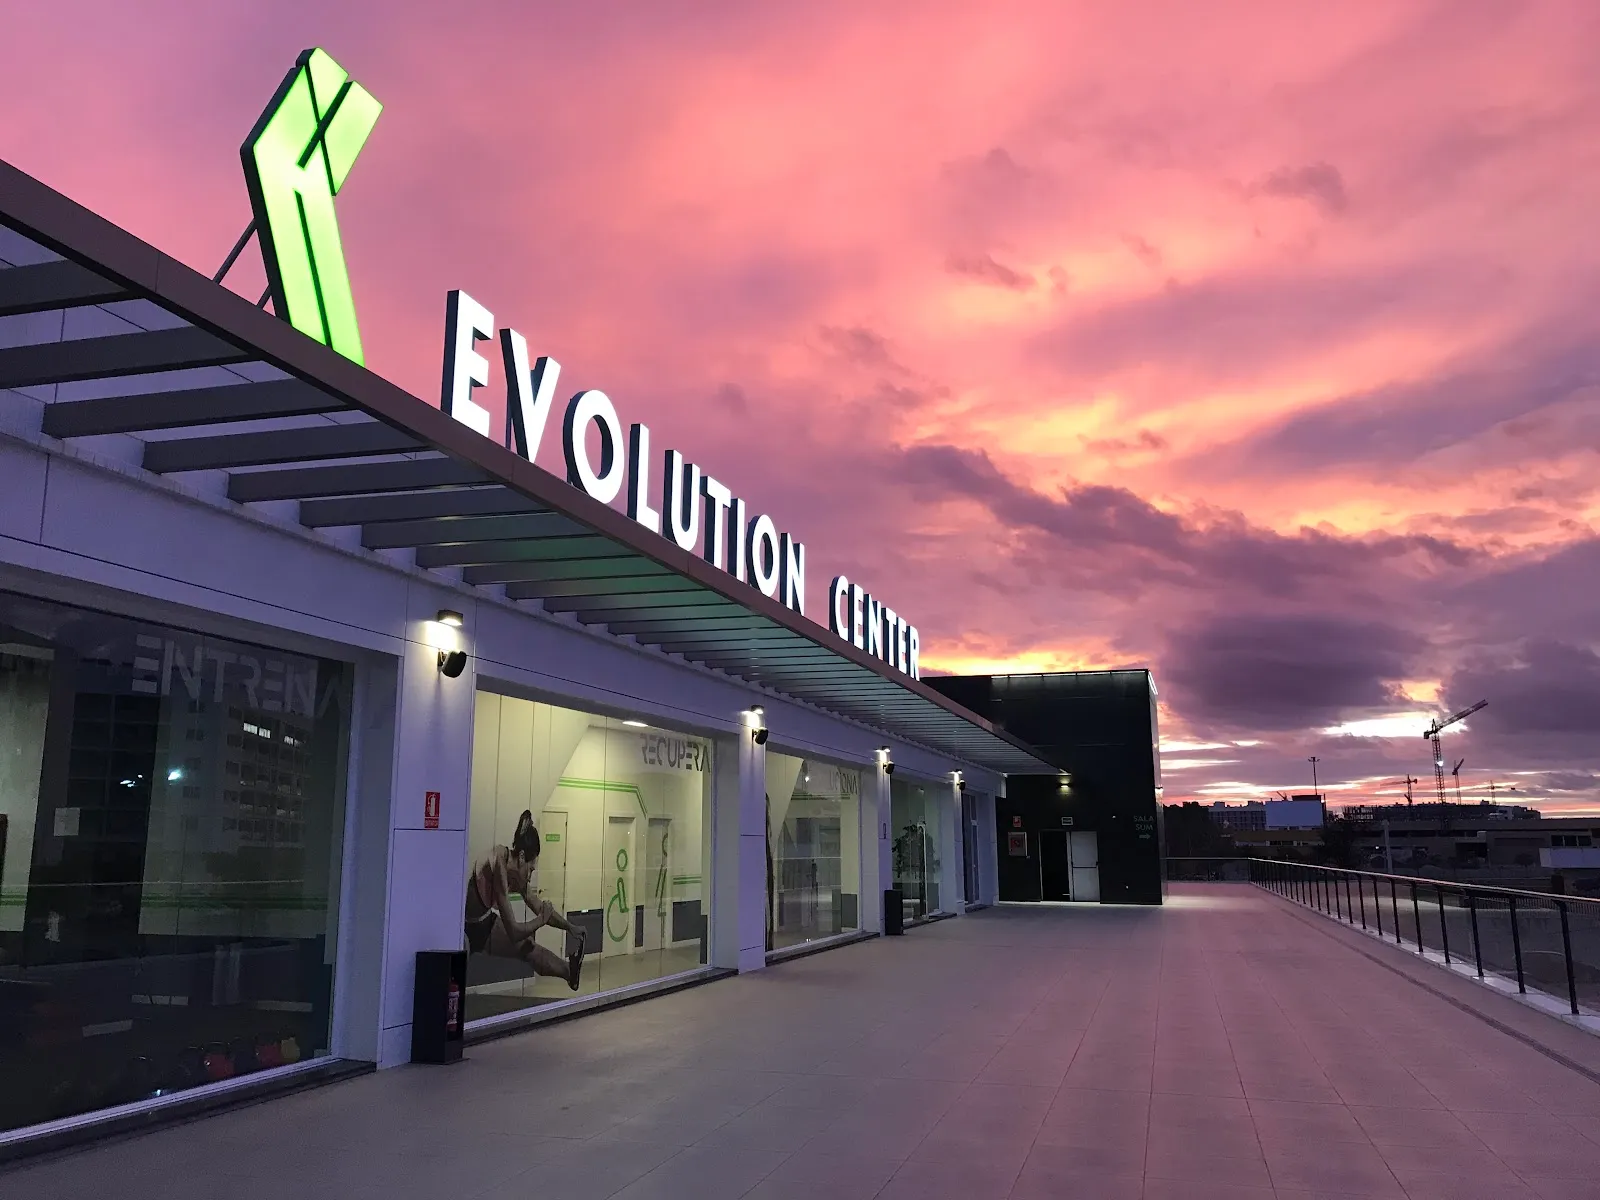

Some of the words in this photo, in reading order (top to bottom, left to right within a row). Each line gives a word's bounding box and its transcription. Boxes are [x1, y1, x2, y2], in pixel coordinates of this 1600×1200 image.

[441, 289, 805, 616] EVOLUTION
[829, 575, 920, 682] CENTER
[132, 633, 352, 719] ENTRENA
[639, 733, 711, 773] RECUPERA
[1135, 823, 1154, 831] SUM
